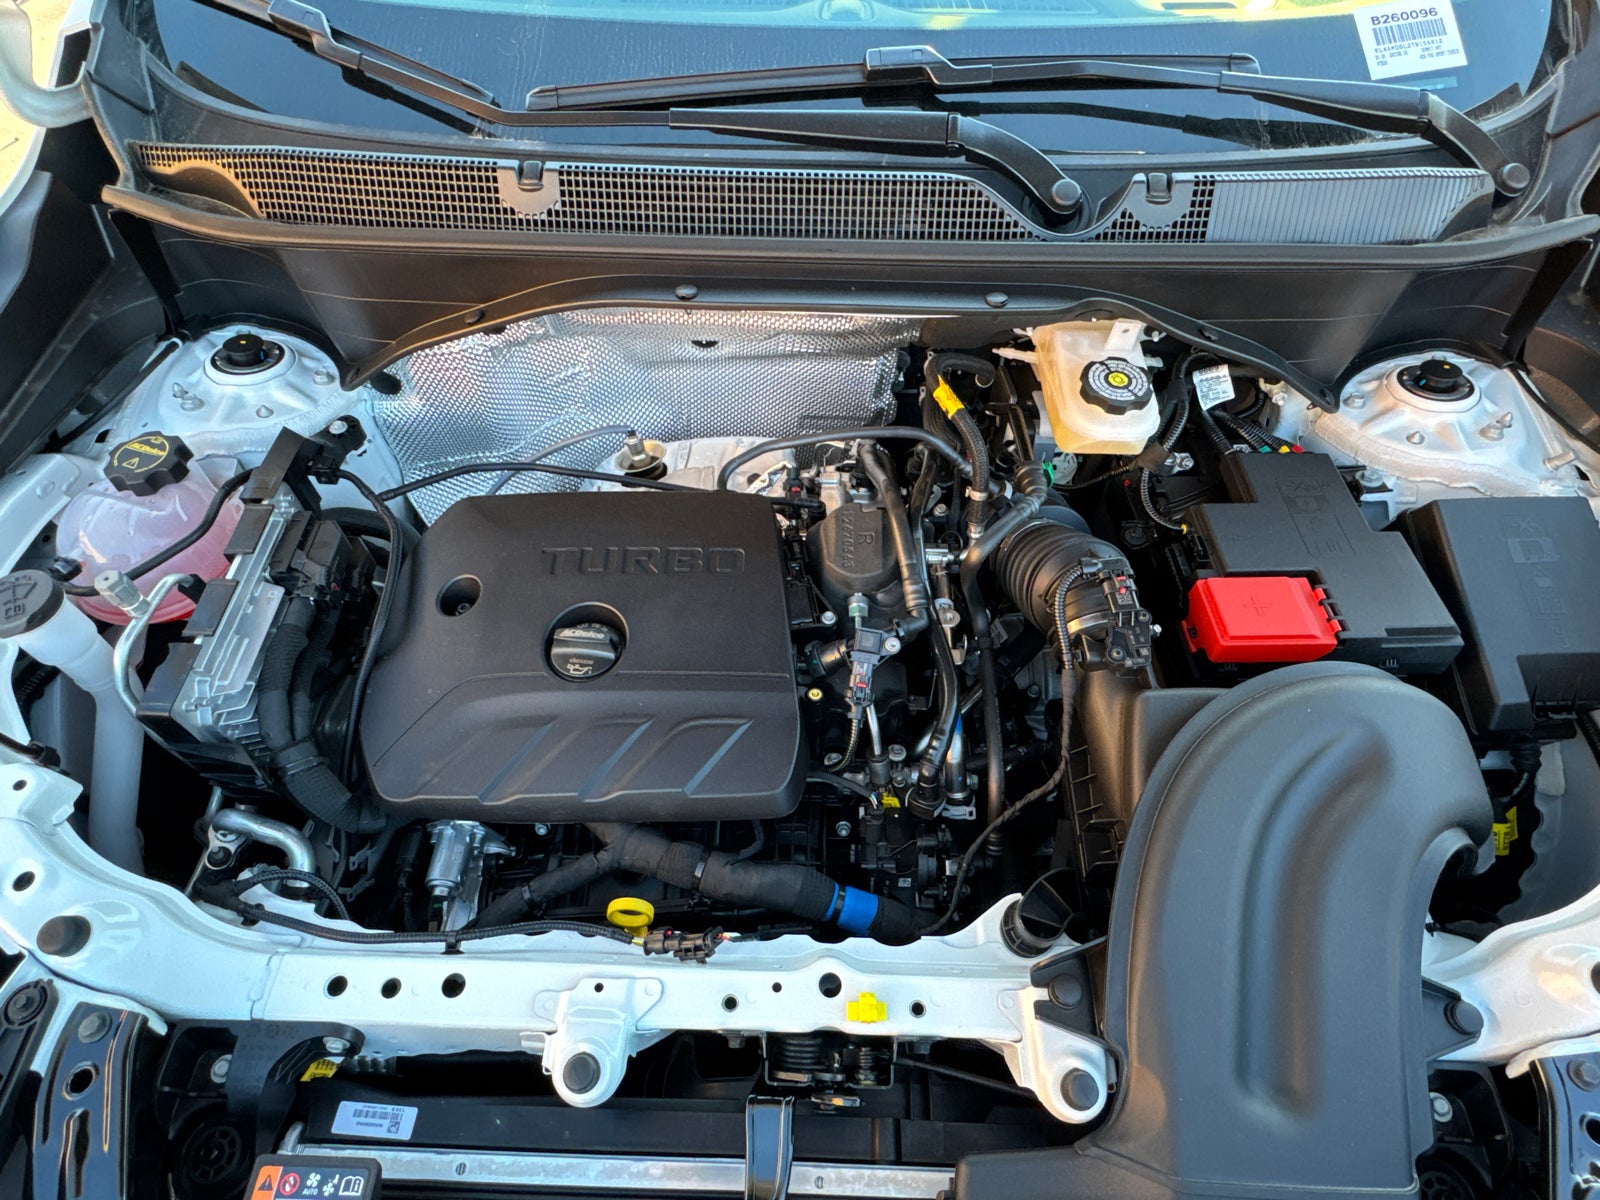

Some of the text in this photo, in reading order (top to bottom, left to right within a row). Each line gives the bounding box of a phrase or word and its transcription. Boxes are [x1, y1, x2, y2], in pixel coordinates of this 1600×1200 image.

[1370, 7, 1438, 26] B260096
[858, 531, 875, 545] R
[541, 546, 746, 576] TURBO
[559, 629, 605, 639] ACDelco
[302, 1187, 319, 1196] AUTO
